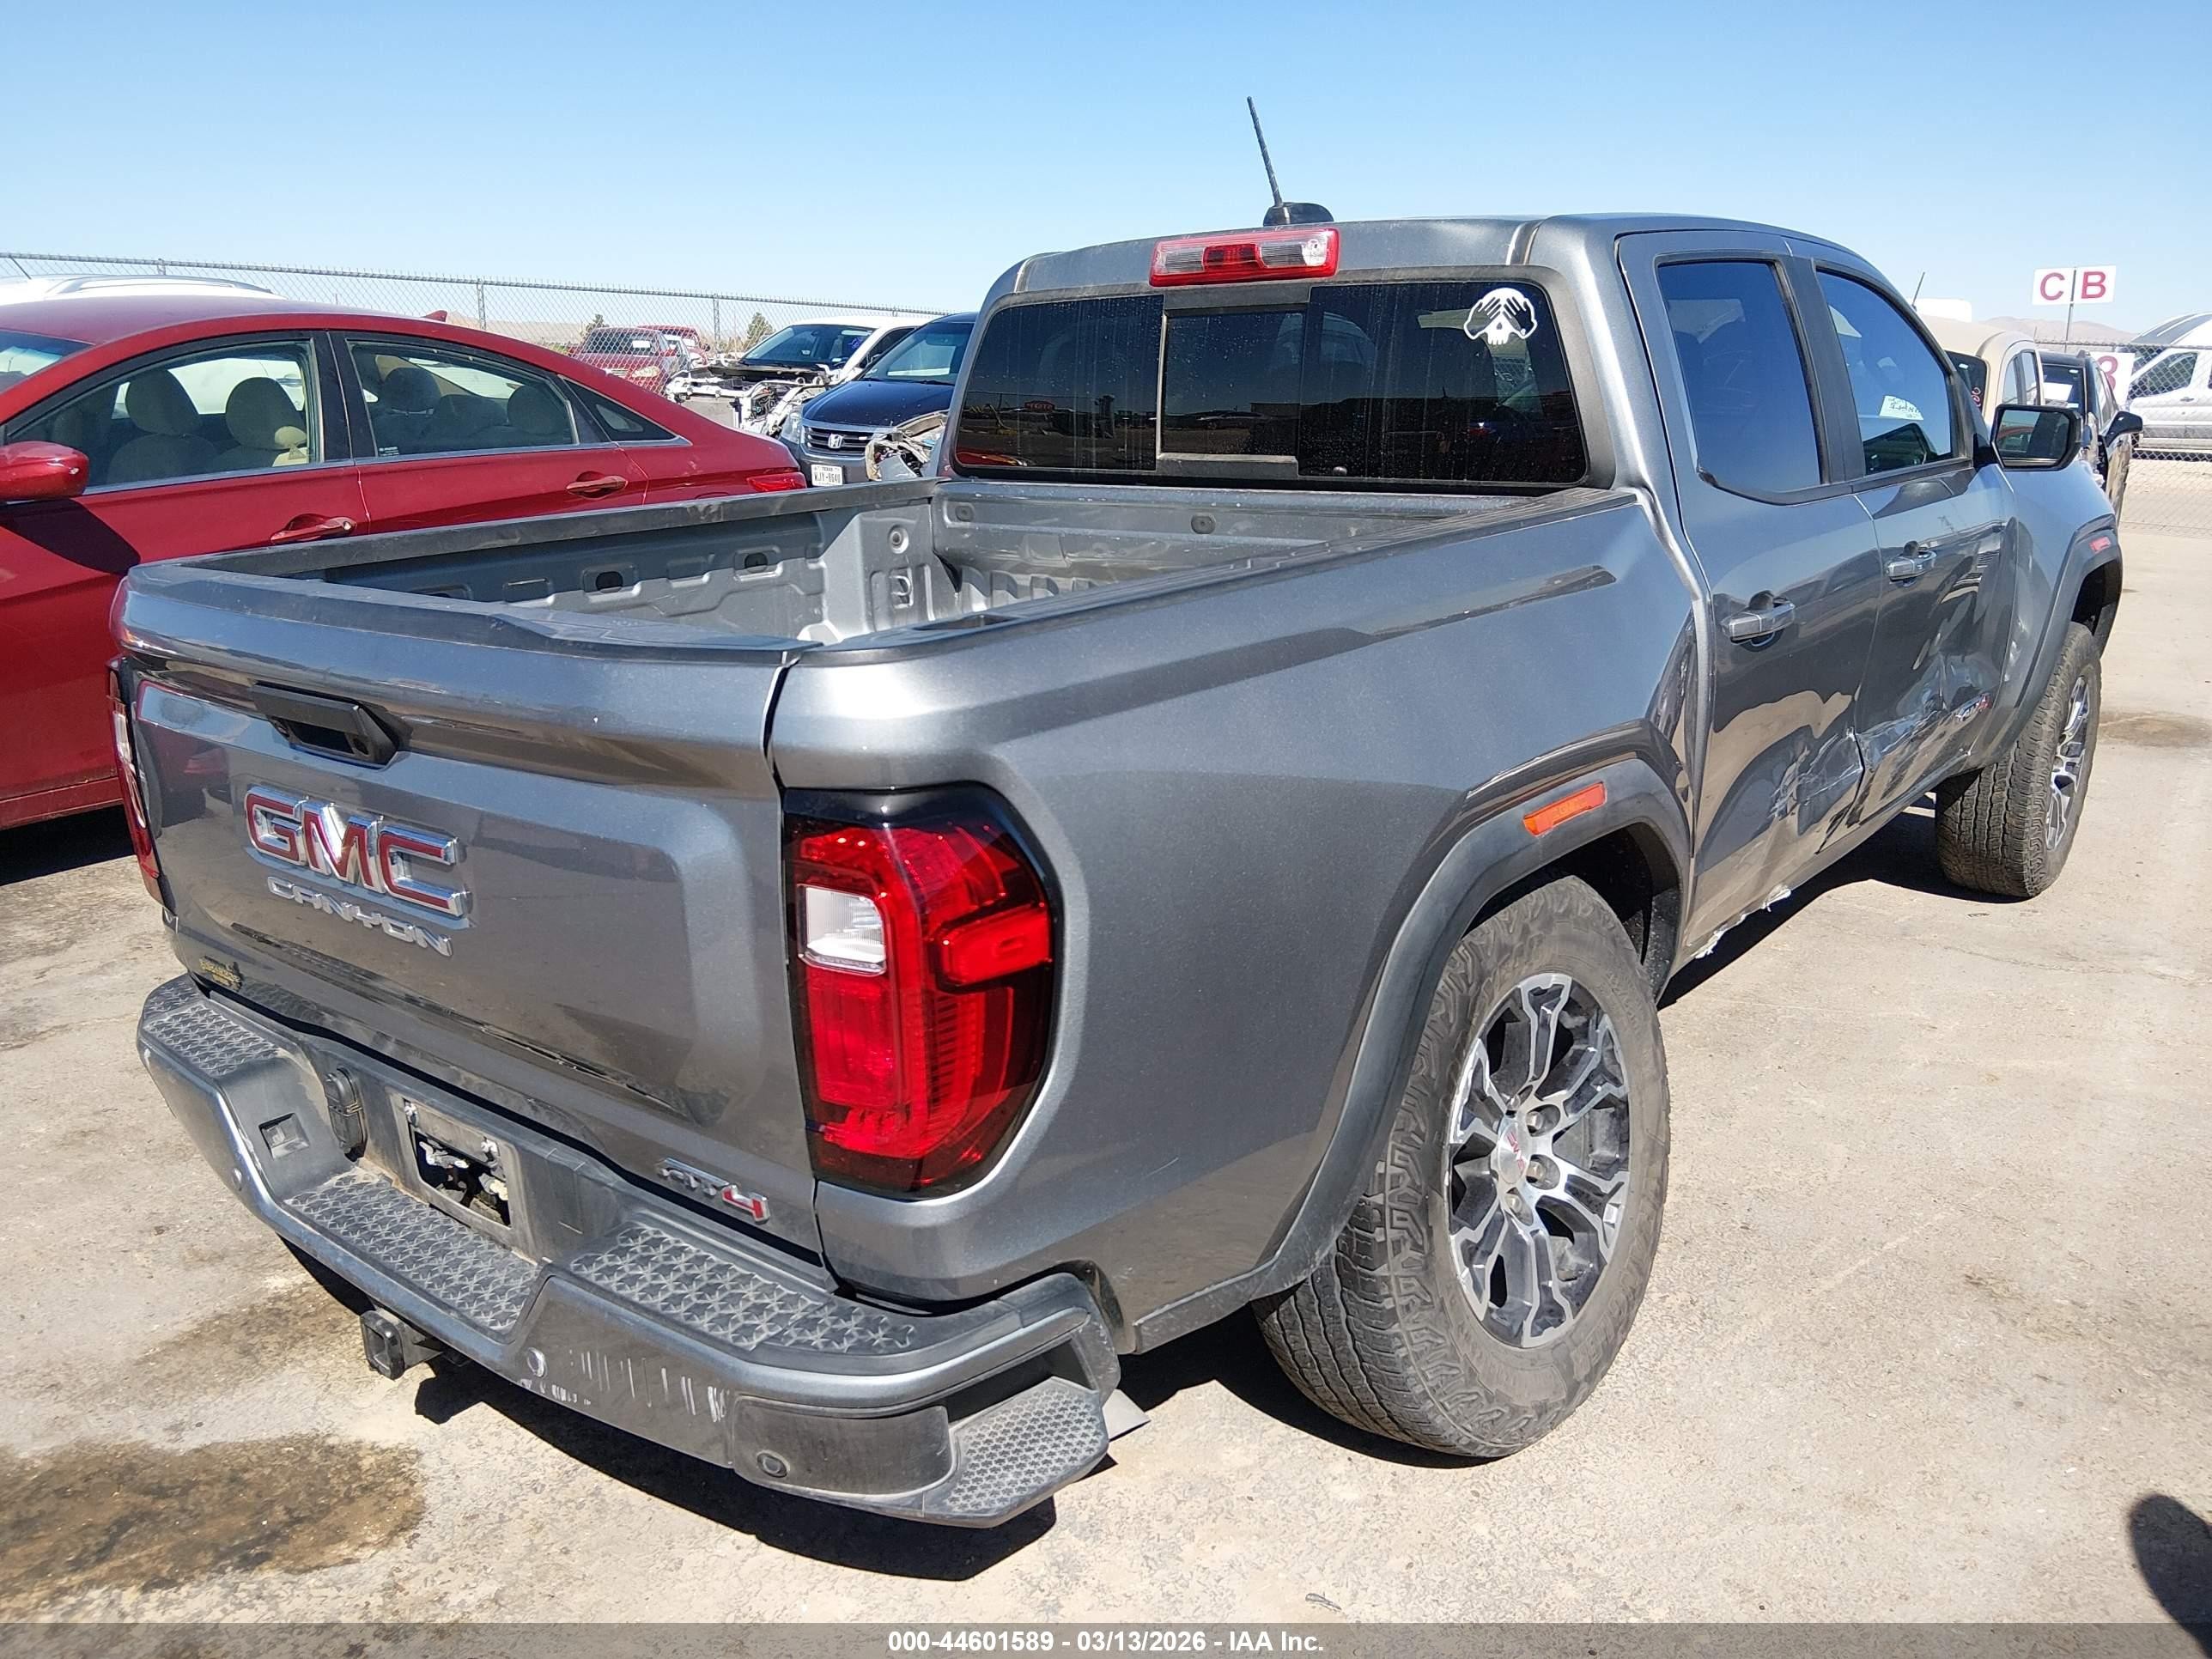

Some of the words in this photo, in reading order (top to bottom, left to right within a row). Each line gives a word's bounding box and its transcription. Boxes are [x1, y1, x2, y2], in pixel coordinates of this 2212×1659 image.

[2039, 271, 2065, 301] C
[2081, 270, 2106, 300] B
[245, 785, 469, 918] GMC
[267, 876, 453, 957] CANYON
[657, 1157, 771, 1223] AT4
